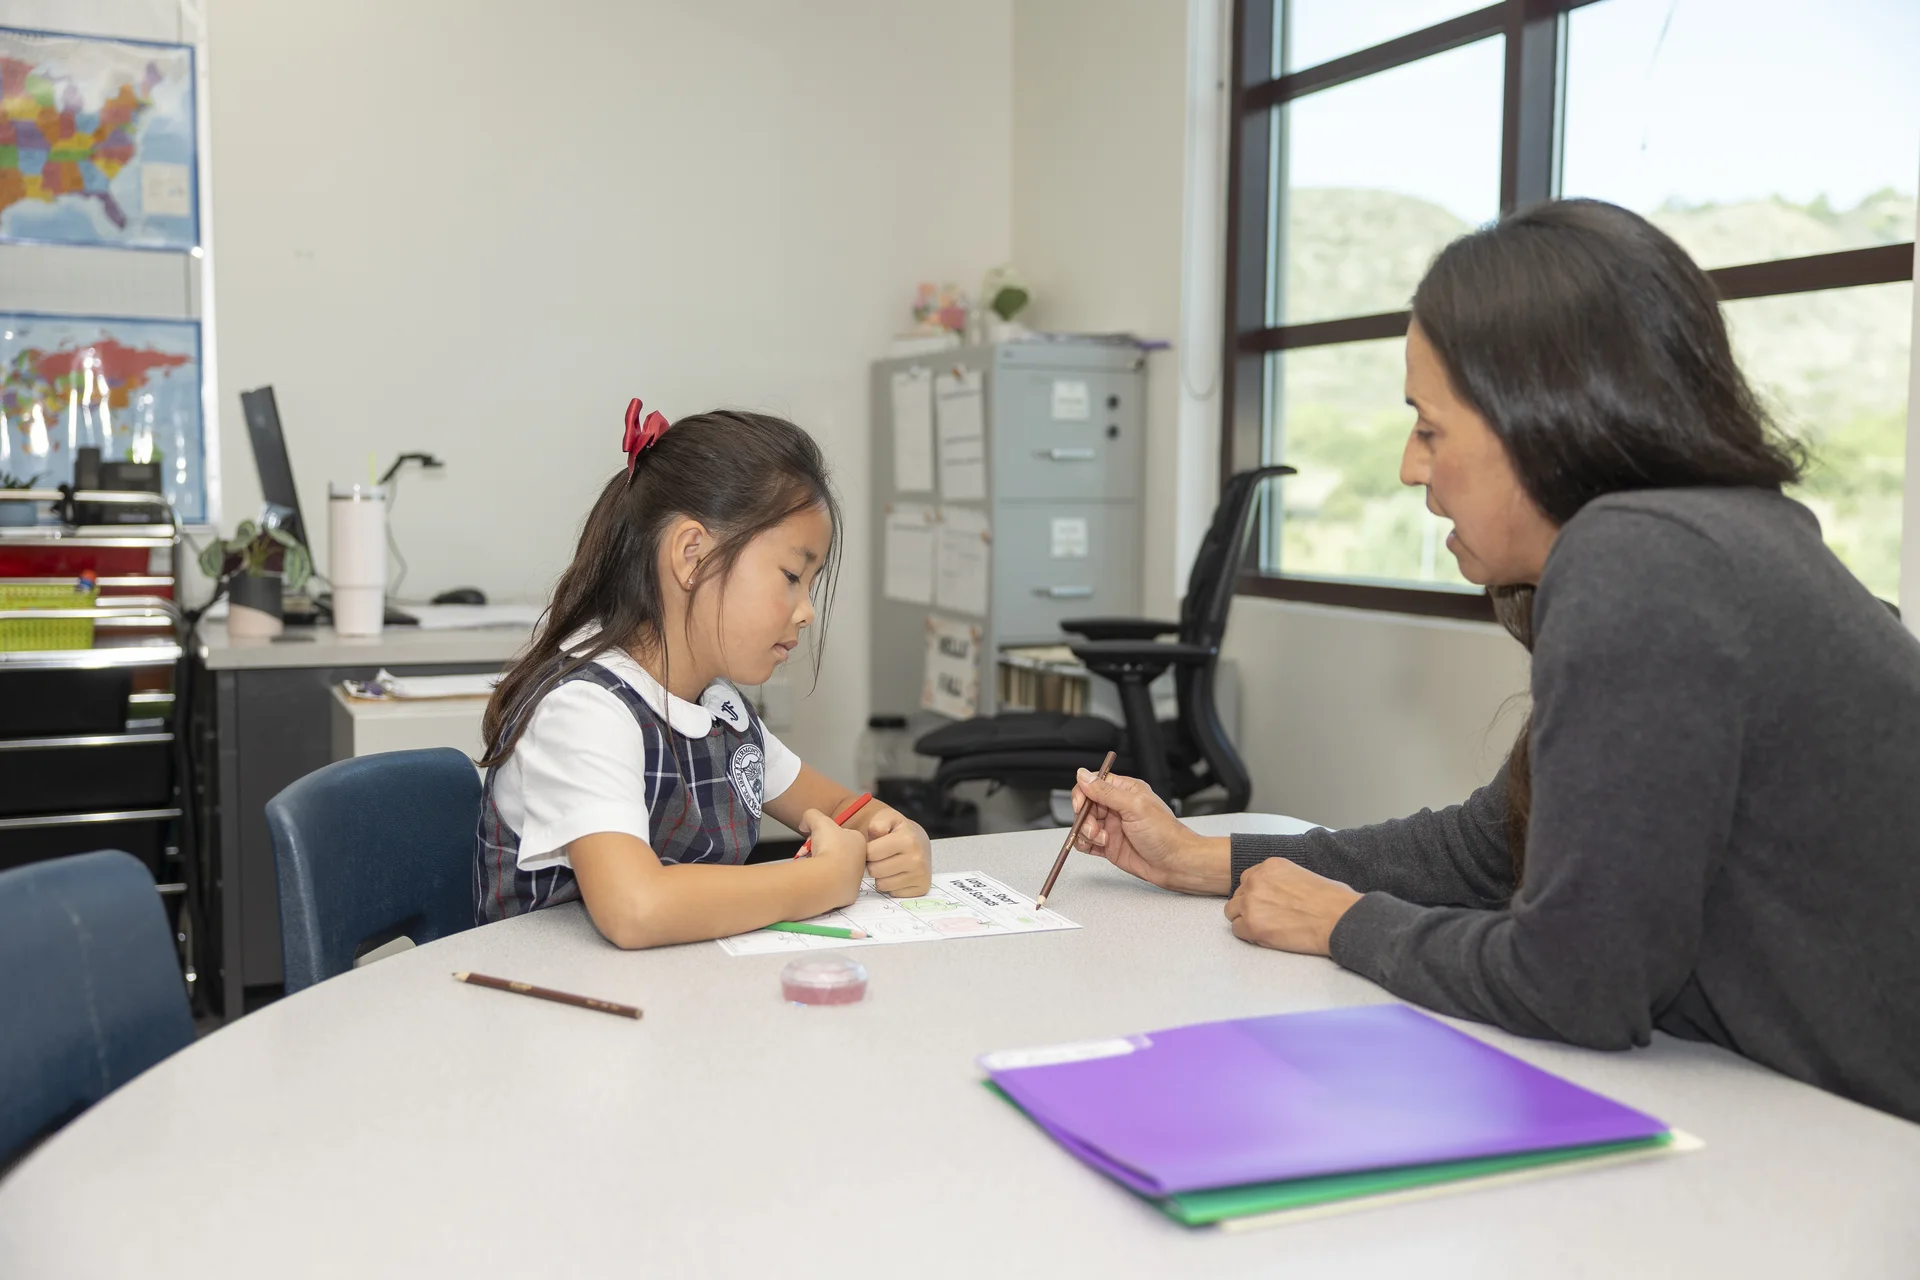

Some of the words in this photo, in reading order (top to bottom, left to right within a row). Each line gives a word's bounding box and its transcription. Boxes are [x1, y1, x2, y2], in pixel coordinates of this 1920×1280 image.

[950, 880, 978, 892] Vowel
[969, 891, 999, 906] Sounds
[965, 878, 987, 888] Long
[992, 893, 1020, 905] Short
